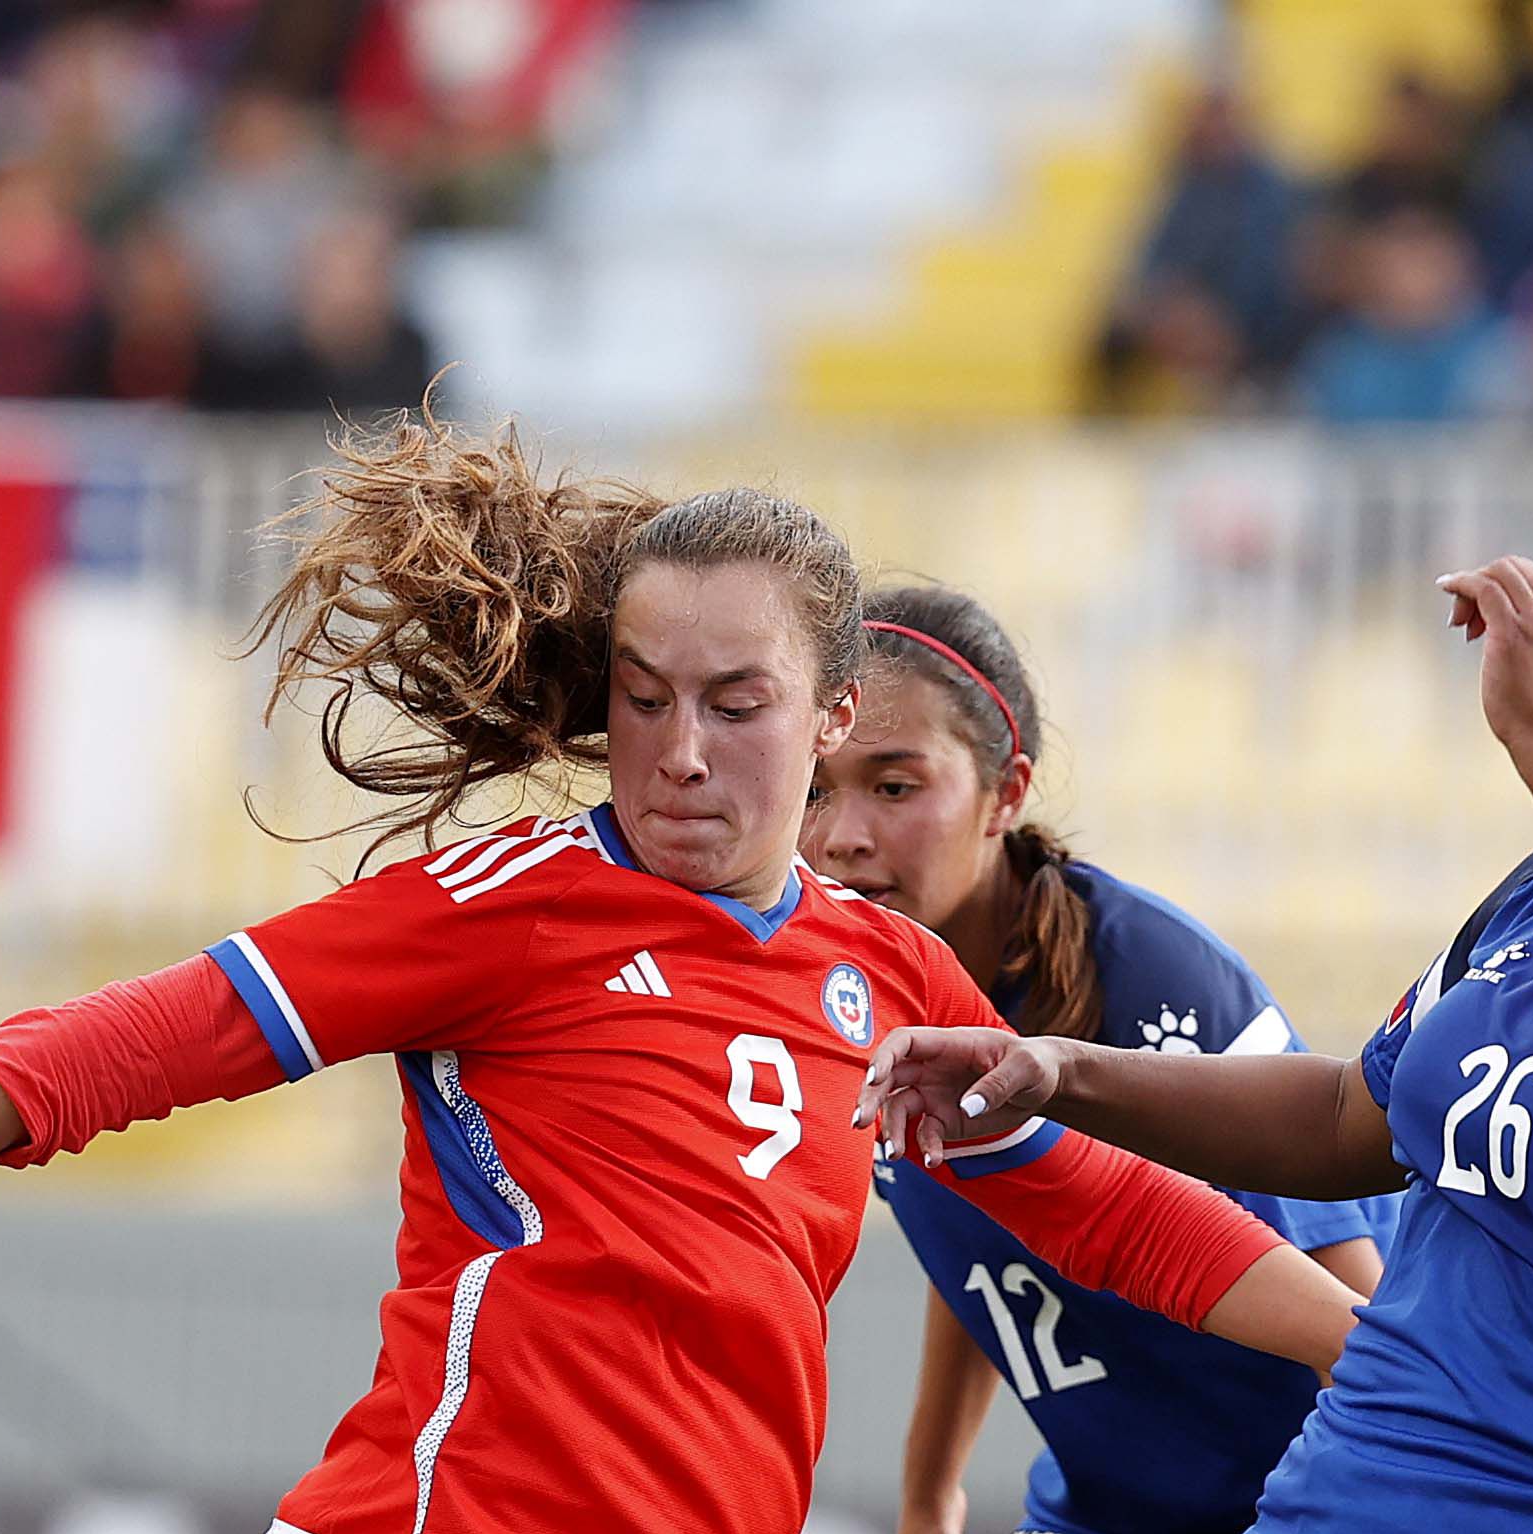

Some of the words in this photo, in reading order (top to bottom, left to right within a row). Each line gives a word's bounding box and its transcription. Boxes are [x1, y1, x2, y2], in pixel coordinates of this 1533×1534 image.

[1464, 967, 1507, 985] ELME
[725, 1033, 804, 1181] 9
[964, 1263, 1108, 1402] 12
